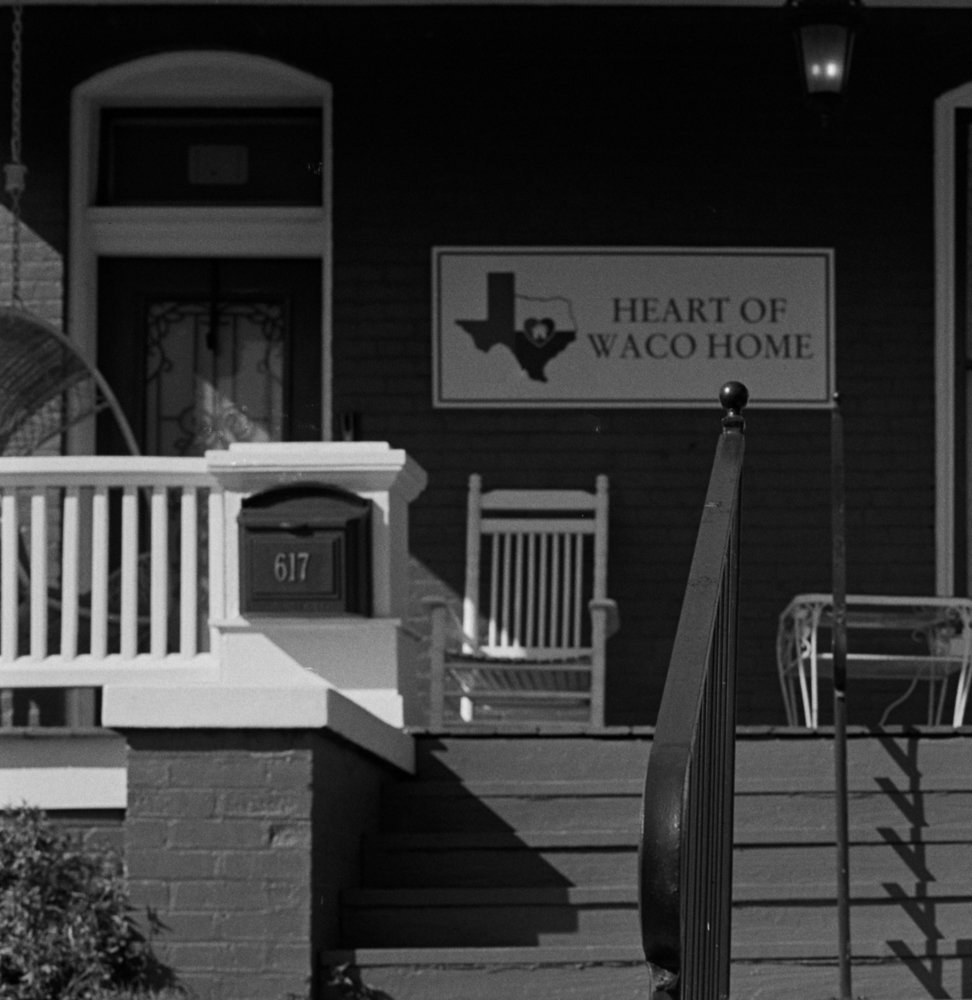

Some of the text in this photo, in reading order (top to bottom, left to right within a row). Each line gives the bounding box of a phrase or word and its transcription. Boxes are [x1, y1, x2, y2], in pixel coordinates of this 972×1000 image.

[612, 297, 788, 323] HEART OF
[587, 333, 814, 359] WACO HOME
[273, 552, 309, 581] 617
